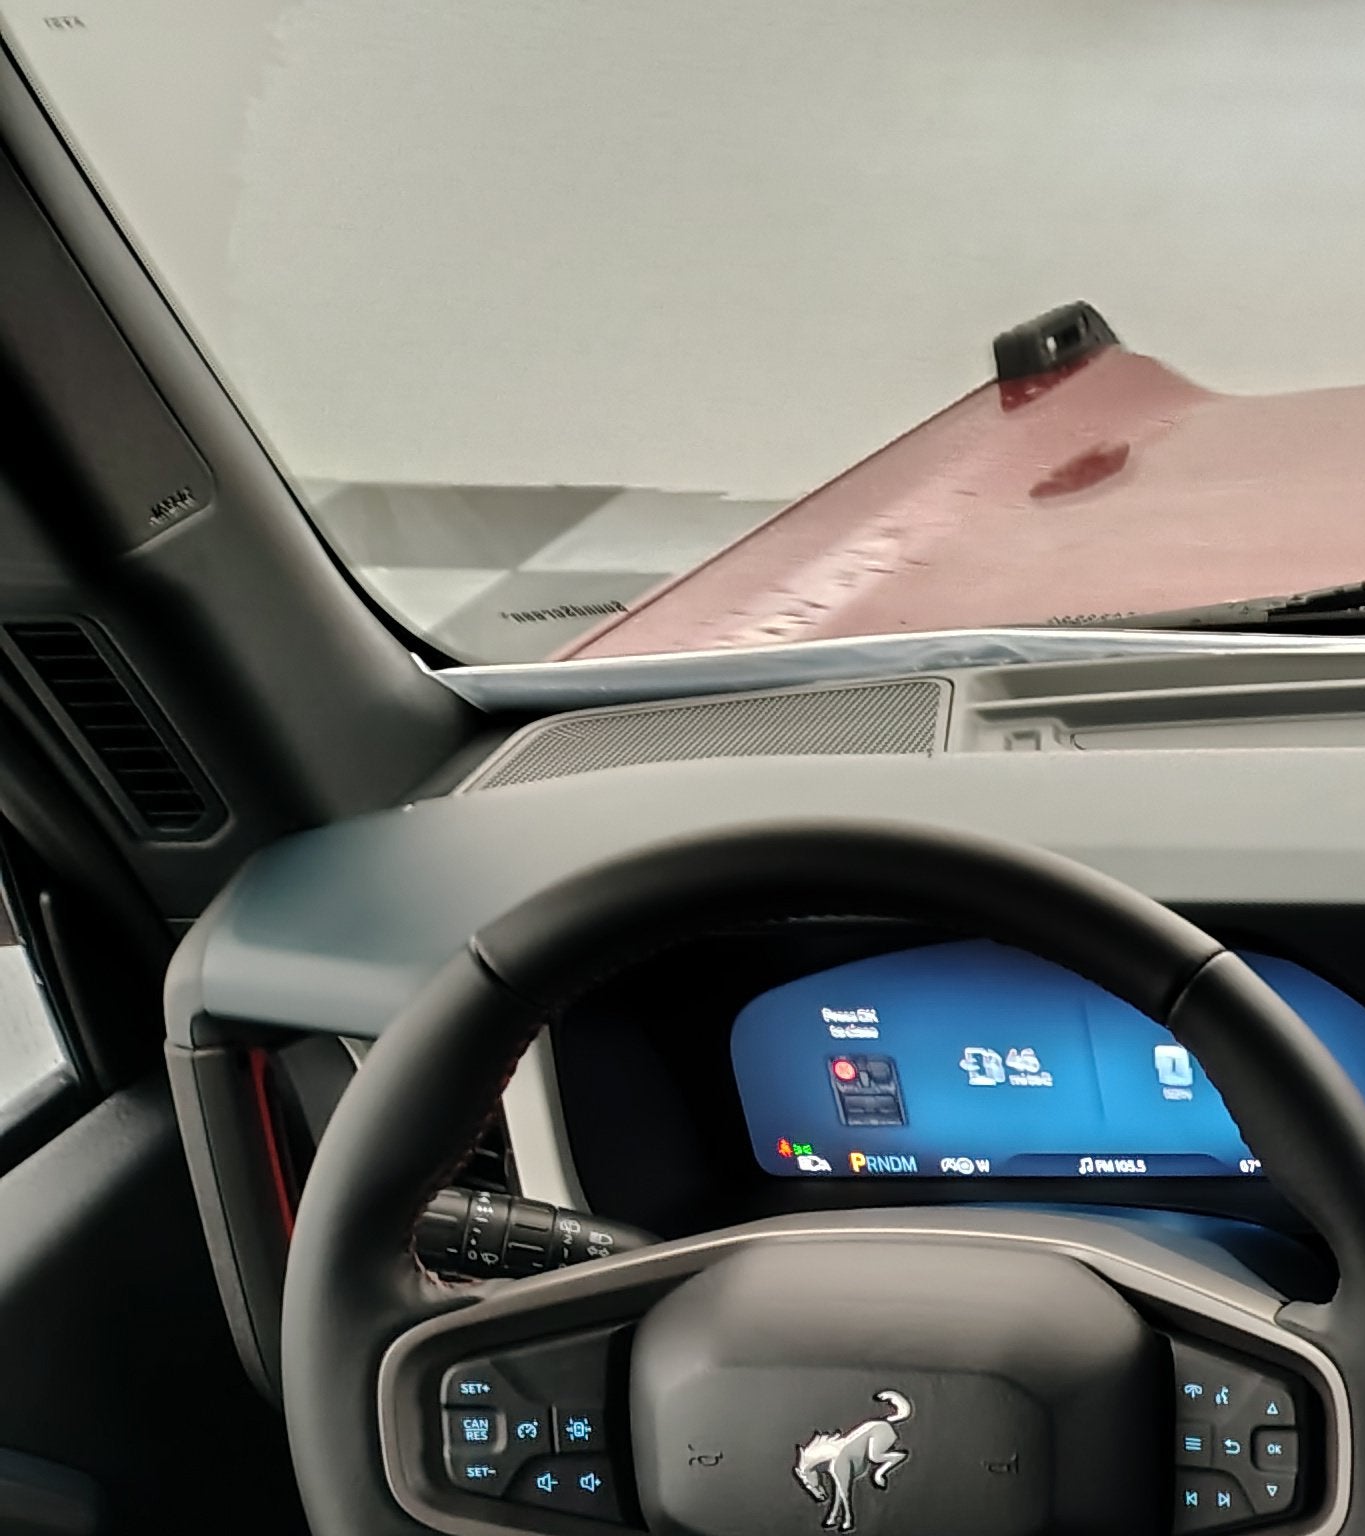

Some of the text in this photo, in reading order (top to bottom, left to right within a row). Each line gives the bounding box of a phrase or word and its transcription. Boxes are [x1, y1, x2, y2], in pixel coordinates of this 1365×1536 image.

[463, 1418, 488, 1430] CAN
[465, 1430, 488, 1441] RES
[1267, 1443, 1282, 1455] OK
